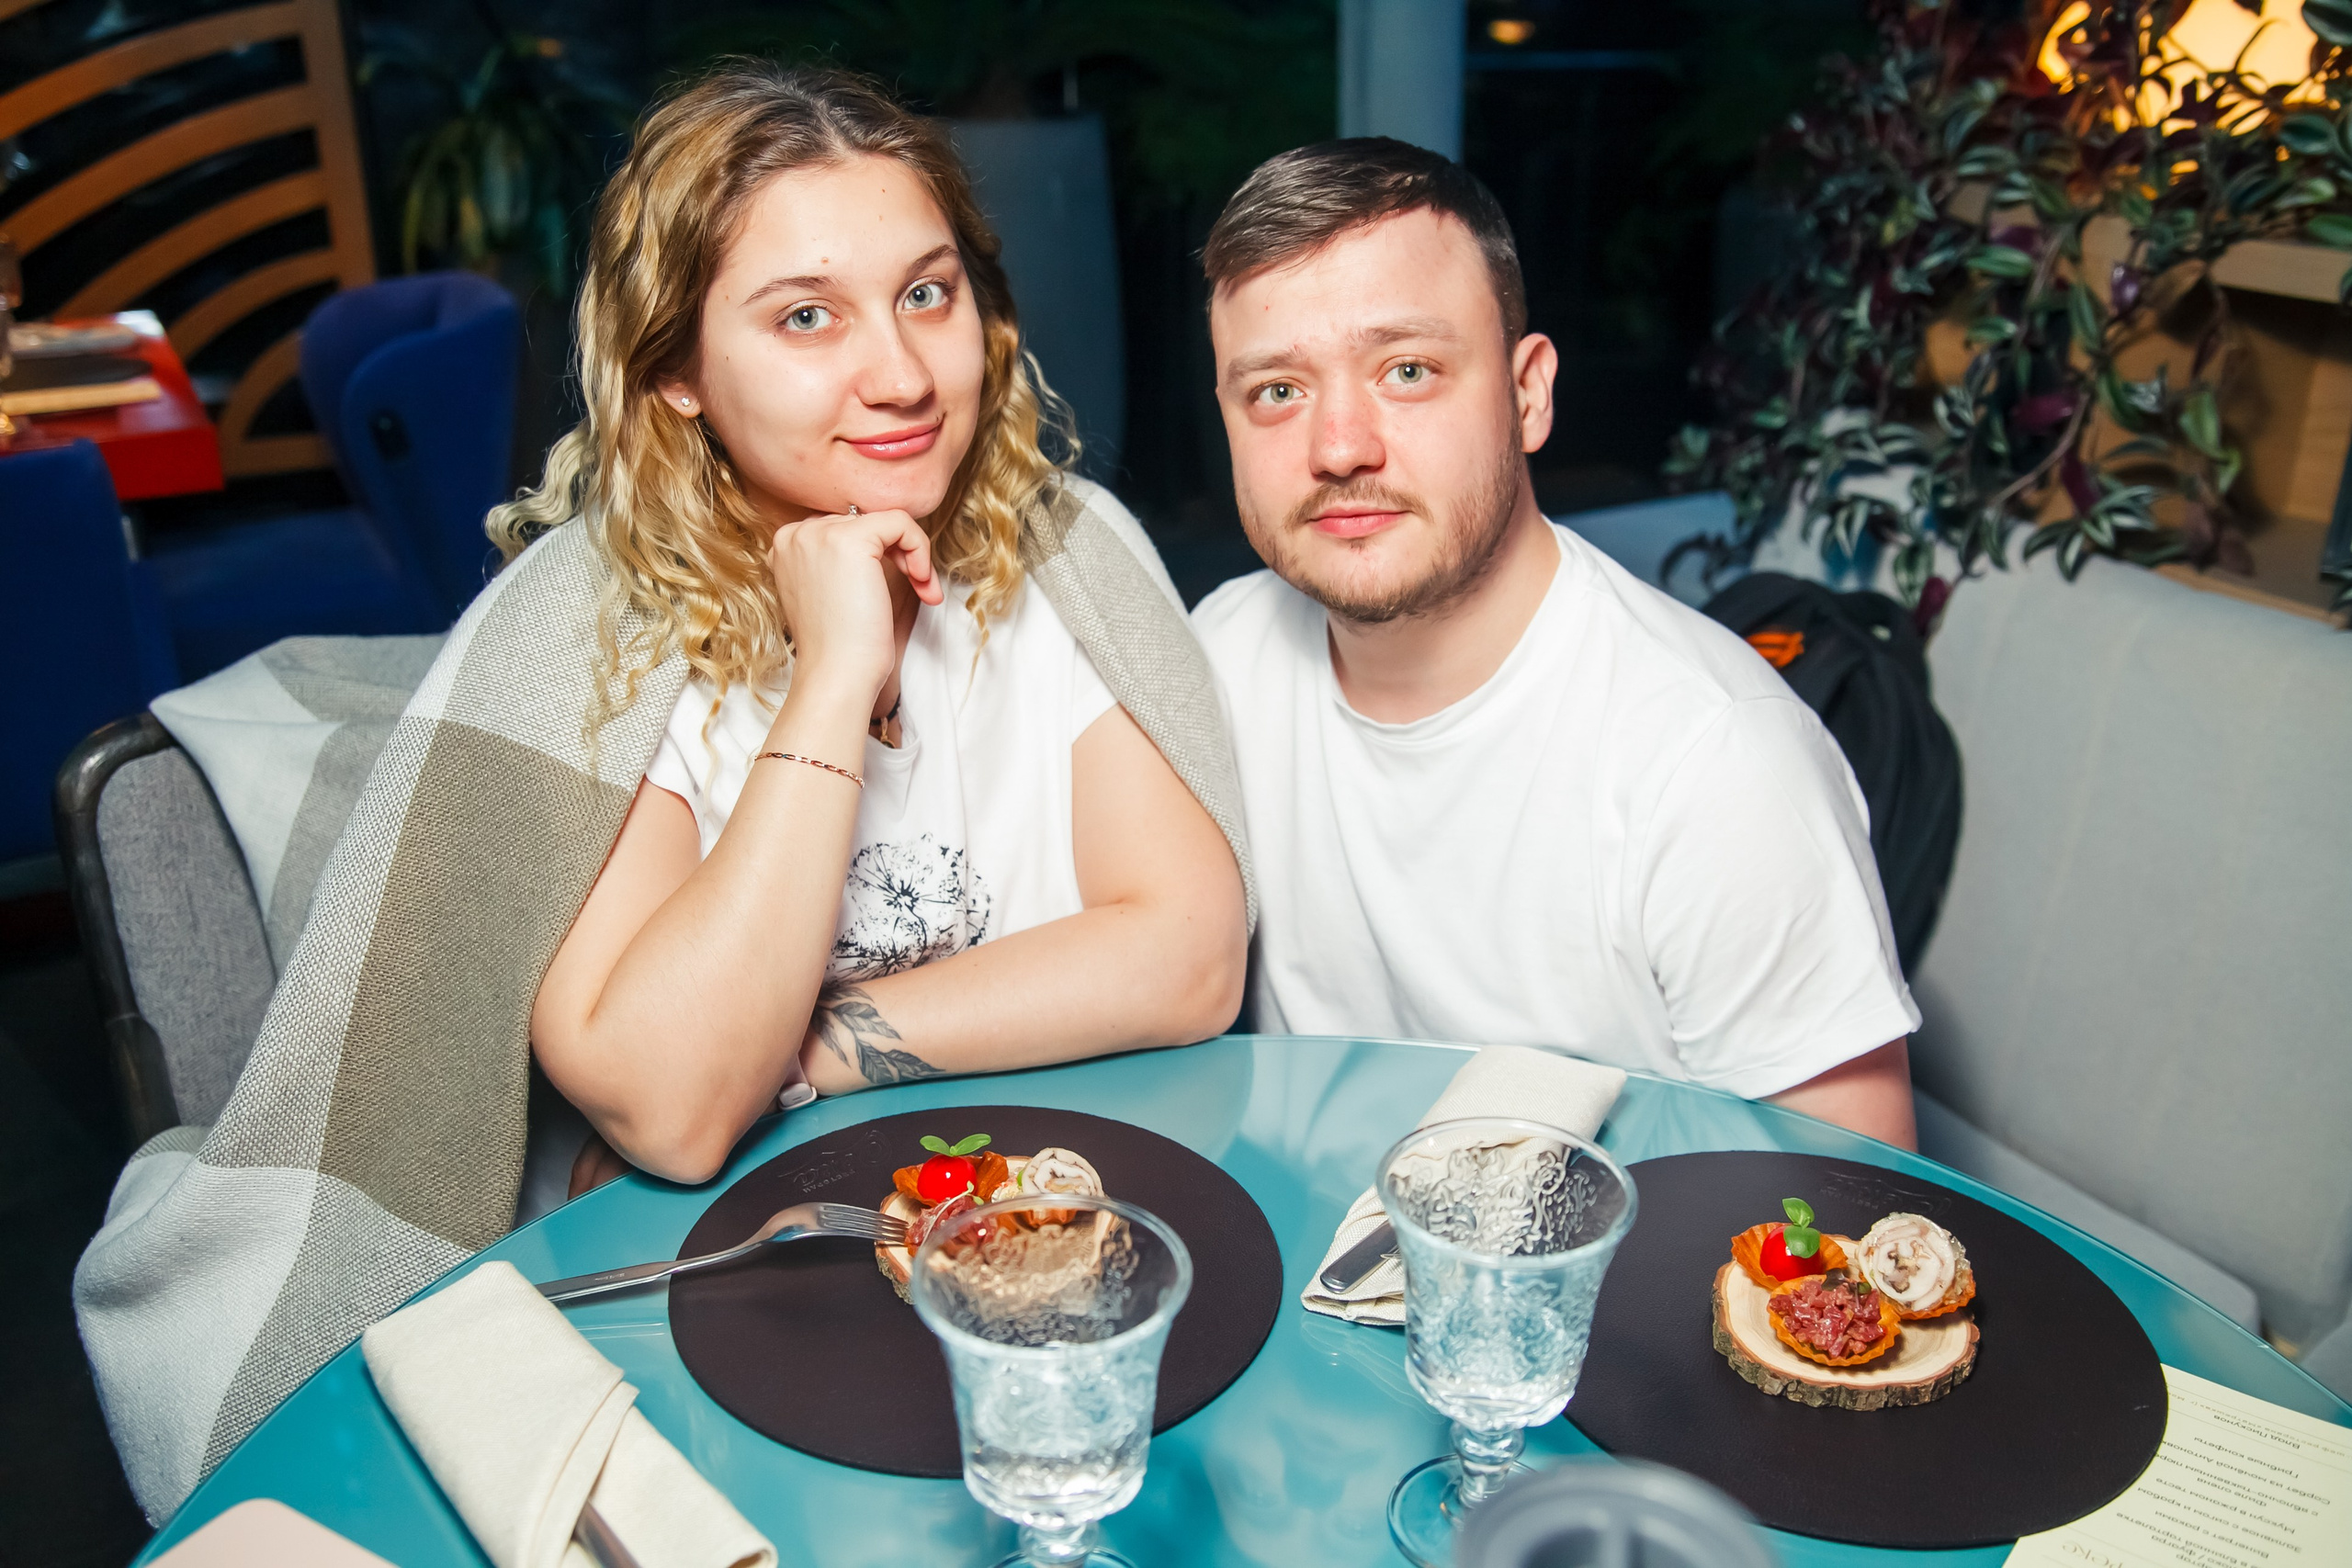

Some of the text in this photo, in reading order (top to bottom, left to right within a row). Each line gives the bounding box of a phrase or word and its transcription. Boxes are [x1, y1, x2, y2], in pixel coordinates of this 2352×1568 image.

[2214, 1416, 2300, 1450] Влад Пискунов
[2163, 1441, 2213, 1462] Антоновк
[2194, 1438, 2299, 1479] Грибные конфеты
[2216, 1461, 2267, 1482] мочёной
[2156, 1478, 2186, 1493] тесте
[2186, 1465, 2308, 1513] яблочно-тыквенным
[2197, 1478, 2267, 1506] Филе оленя
[2286, 1486, 2330, 1505] Сорбет
[2138, 1487, 2180, 1506] крабом
[2190, 1491, 2237, 1512] ржаном
[2117, 1513, 2181, 1541] тарталетке
[2155, 1511, 2200, 1531] раками
[2194, 1509, 2229, 1525] сигом
[2249, 1514, 2295, 1534] Муксун
[2152, 1535, 2196, 1556] фуагра
[2212, 1534, 2269, 1559] Винегрет
[2242, 1528, 2301, 1553] Заливное
[2186, 1540, 2237, 1564] блинной
